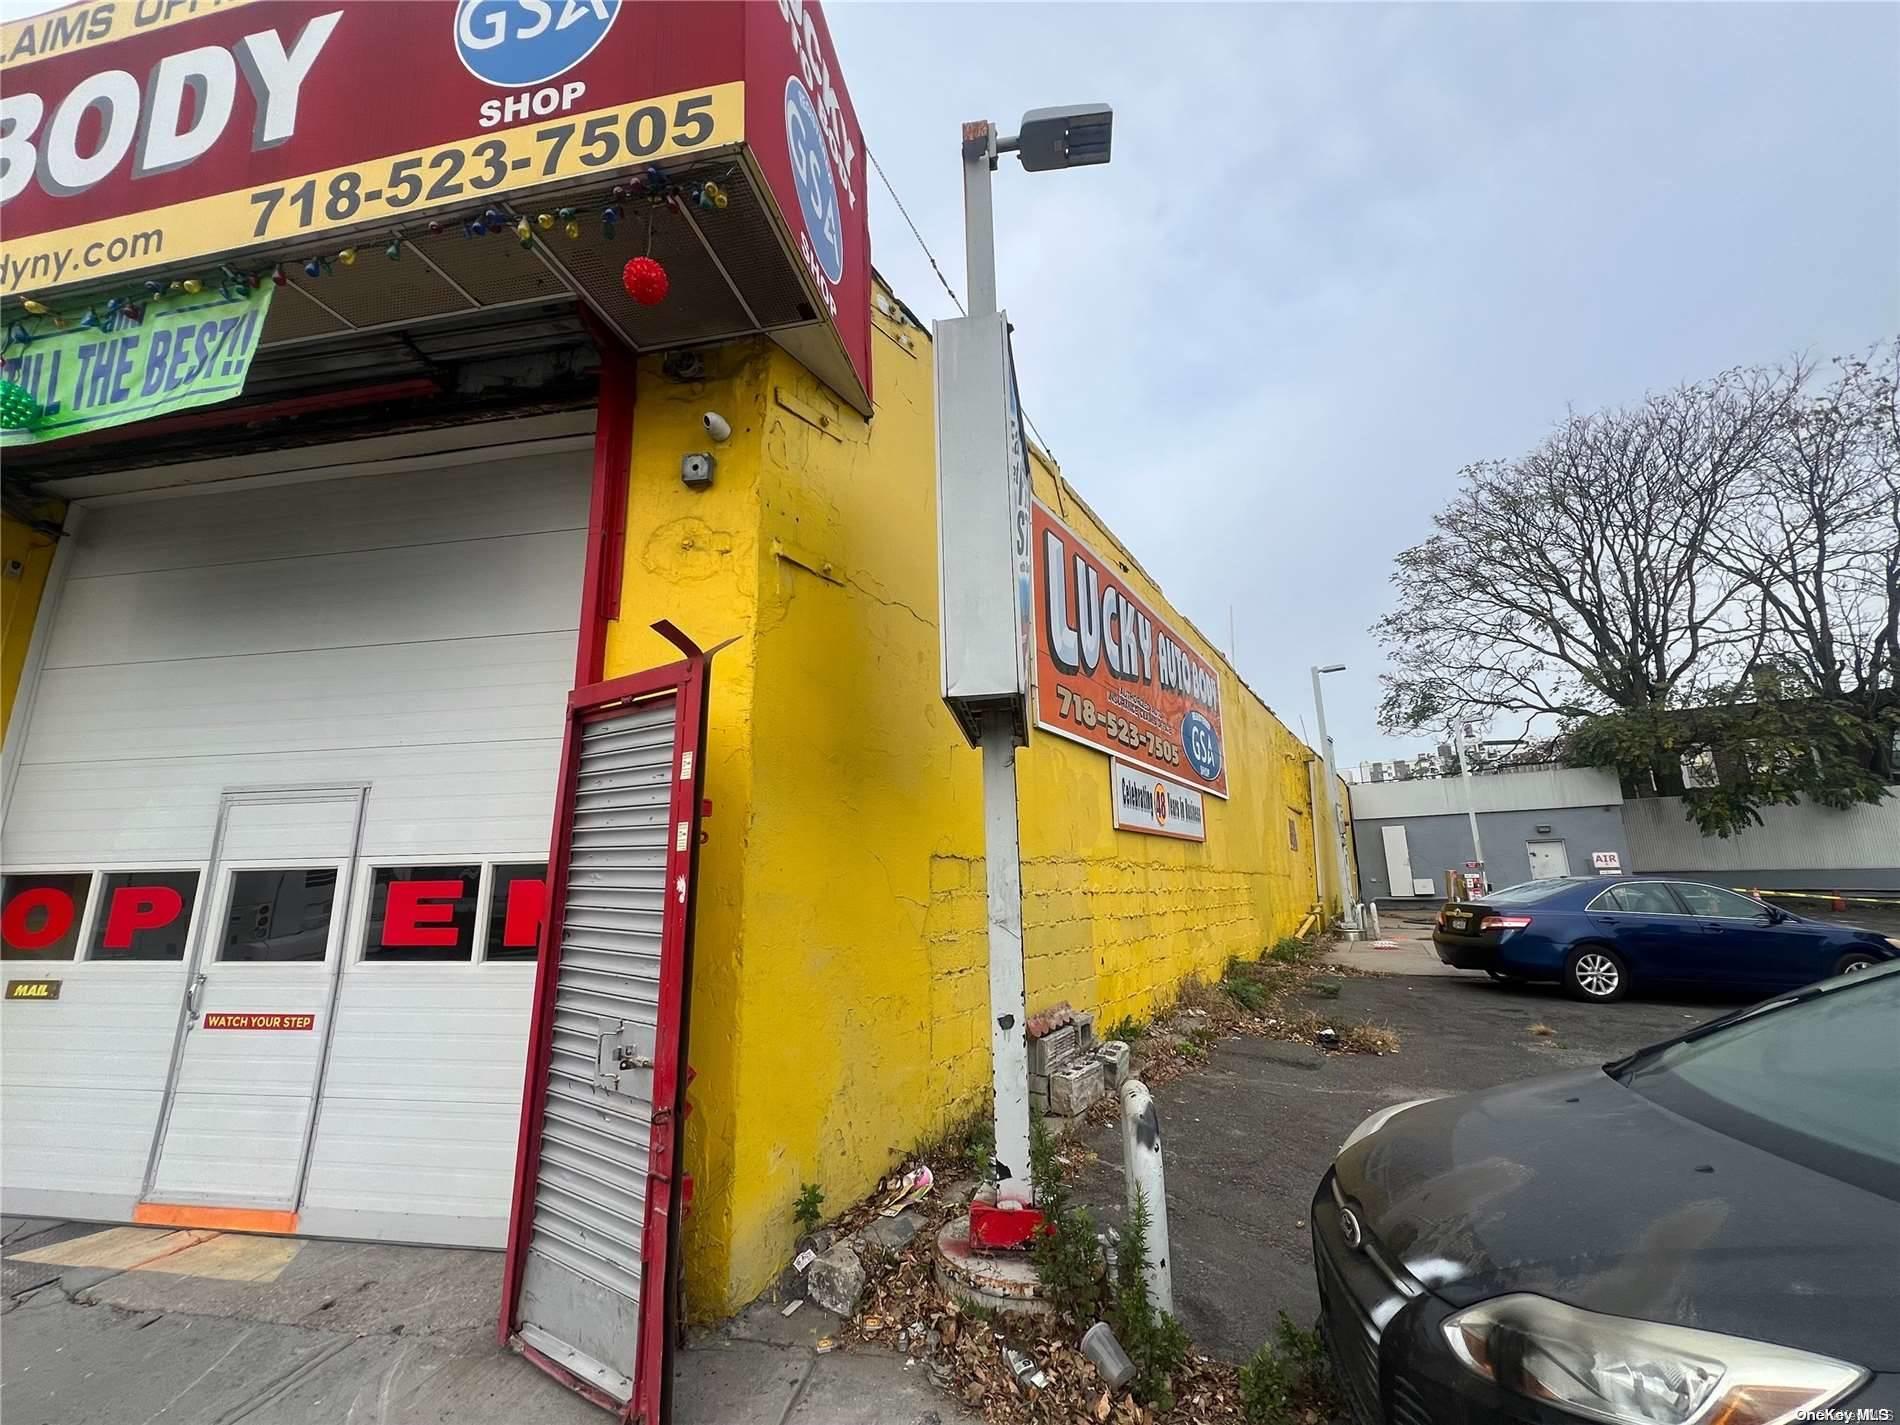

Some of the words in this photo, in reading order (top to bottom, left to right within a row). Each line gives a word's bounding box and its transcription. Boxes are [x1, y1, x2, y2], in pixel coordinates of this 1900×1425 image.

[0, 4, 115, 63] AIMS
[479, 81, 586, 127] SHOP
[251, 95, 715, 237] 718-523-7505
[787, 99, 840, 268] GSA
[800, 231, 837, 316] SHOP
[72, 335, 140, 411] THE
[141, 309, 260, 397] BEST!!
[1044, 529, 1151, 683] LUCKY
[1158, 632, 1190, 695] AUTO
[1193, 662, 1217, 711] BODY
[1056, 684, 1180, 766] 718-523-7505
[1192, 726, 1215, 767] GSA
[1122, 777, 1154, 819] Celebrating
[1156, 791, 1166, 819] 48
[1596, 854, 1617, 863] AIR
[13, 984, 48, 996] MAIL
[208, 1016, 248, 1027] WATCH
[250, 1016, 281, 1027] YOUR
[283, 1017, 311, 1028] STEP
